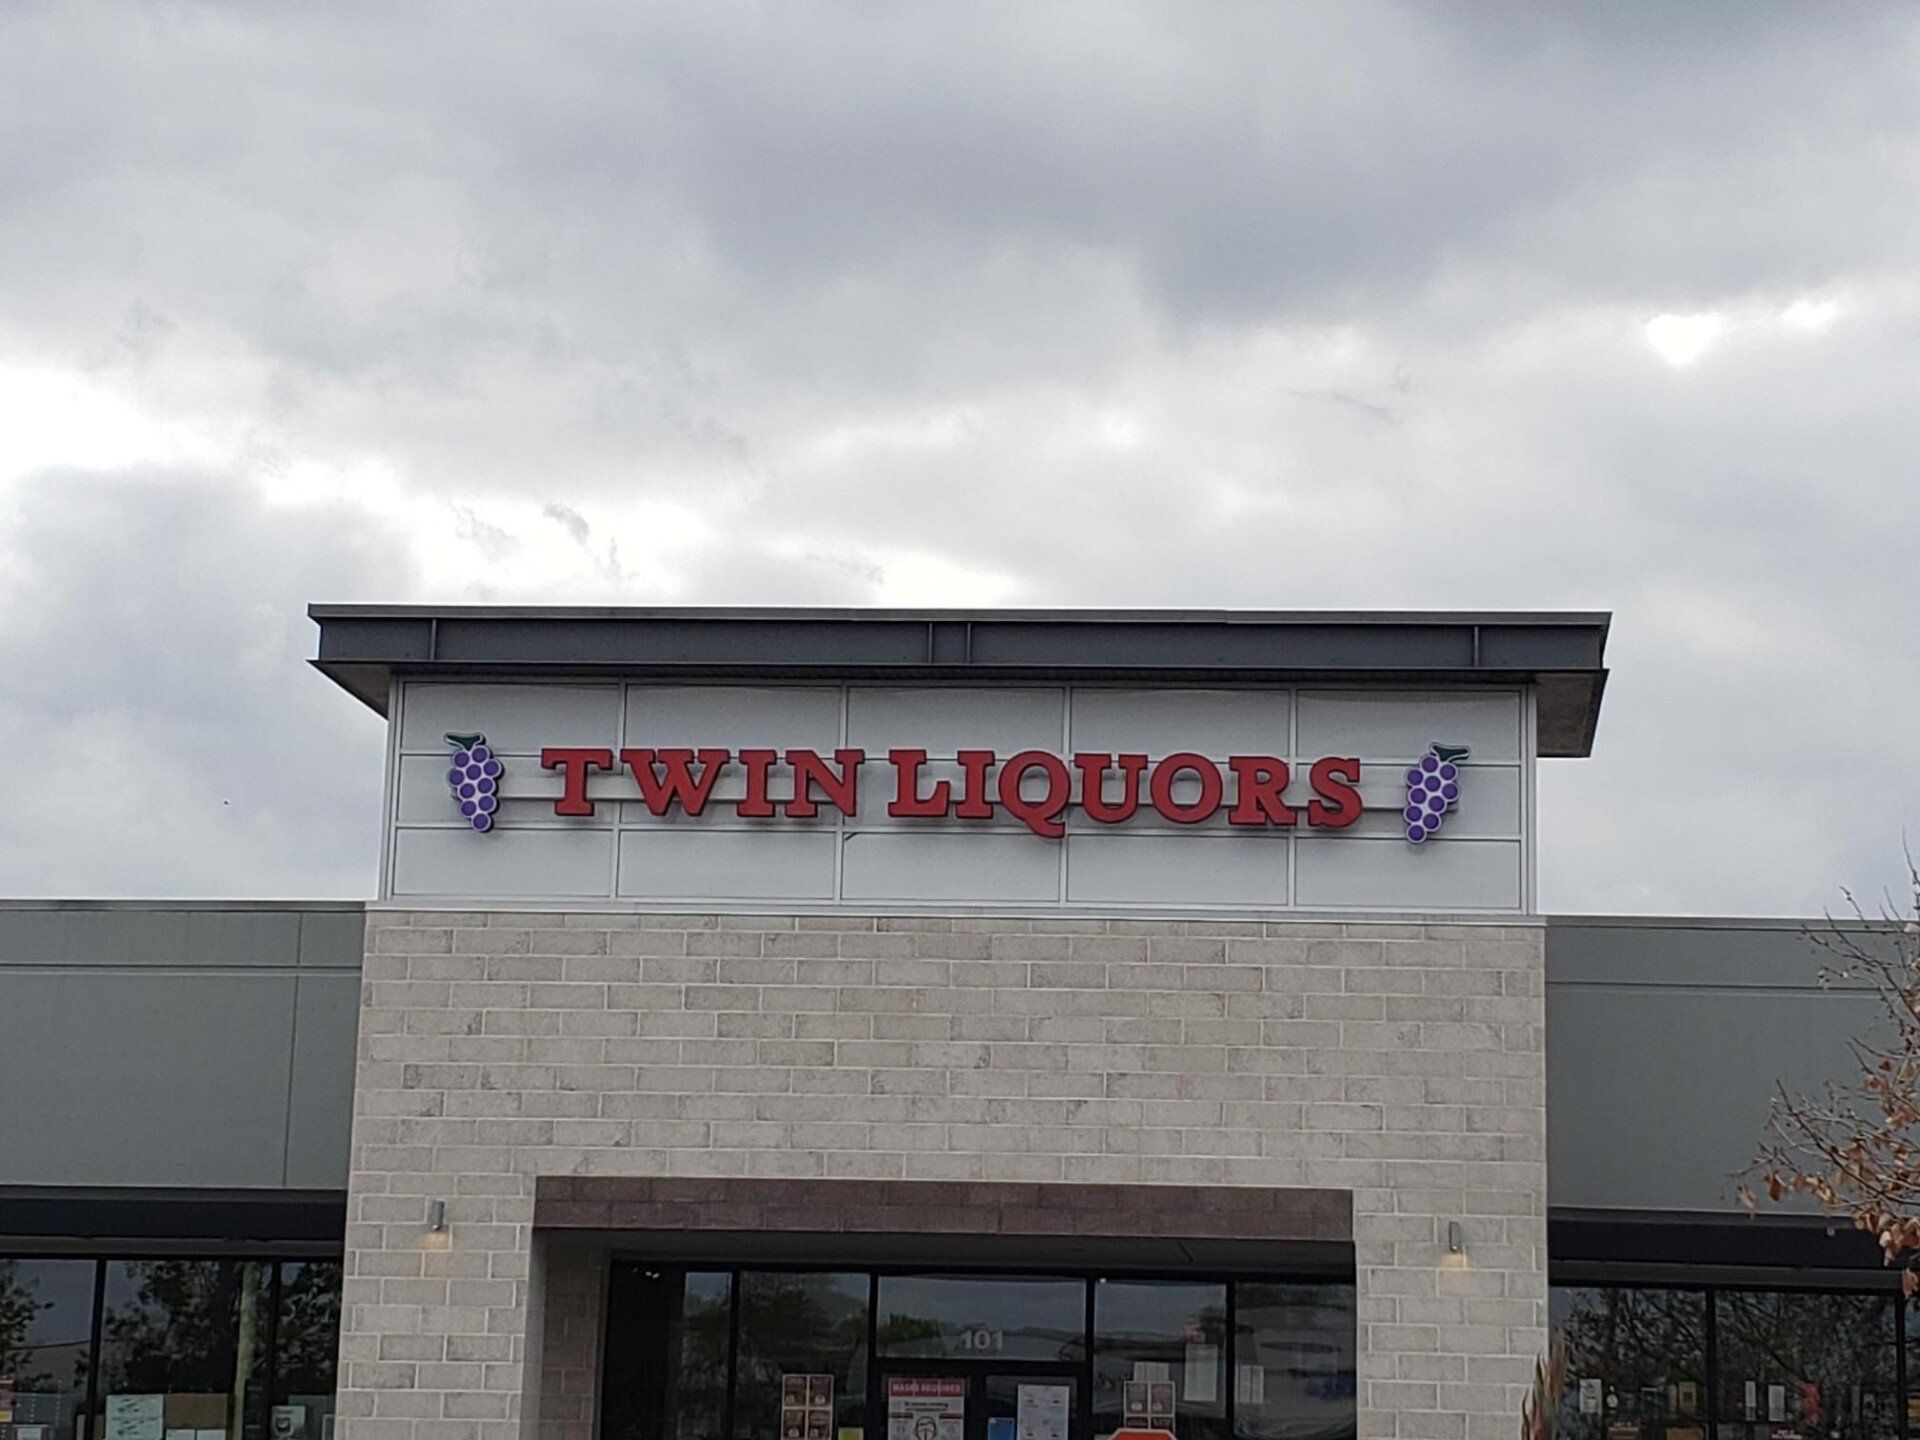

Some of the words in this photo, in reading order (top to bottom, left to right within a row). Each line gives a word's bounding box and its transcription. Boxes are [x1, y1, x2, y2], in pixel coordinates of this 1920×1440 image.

[541, 748, 864, 817] TWIN
[888, 749, 1363, 837] LIQUORS
[960, 1329, 1004, 1349] 101
